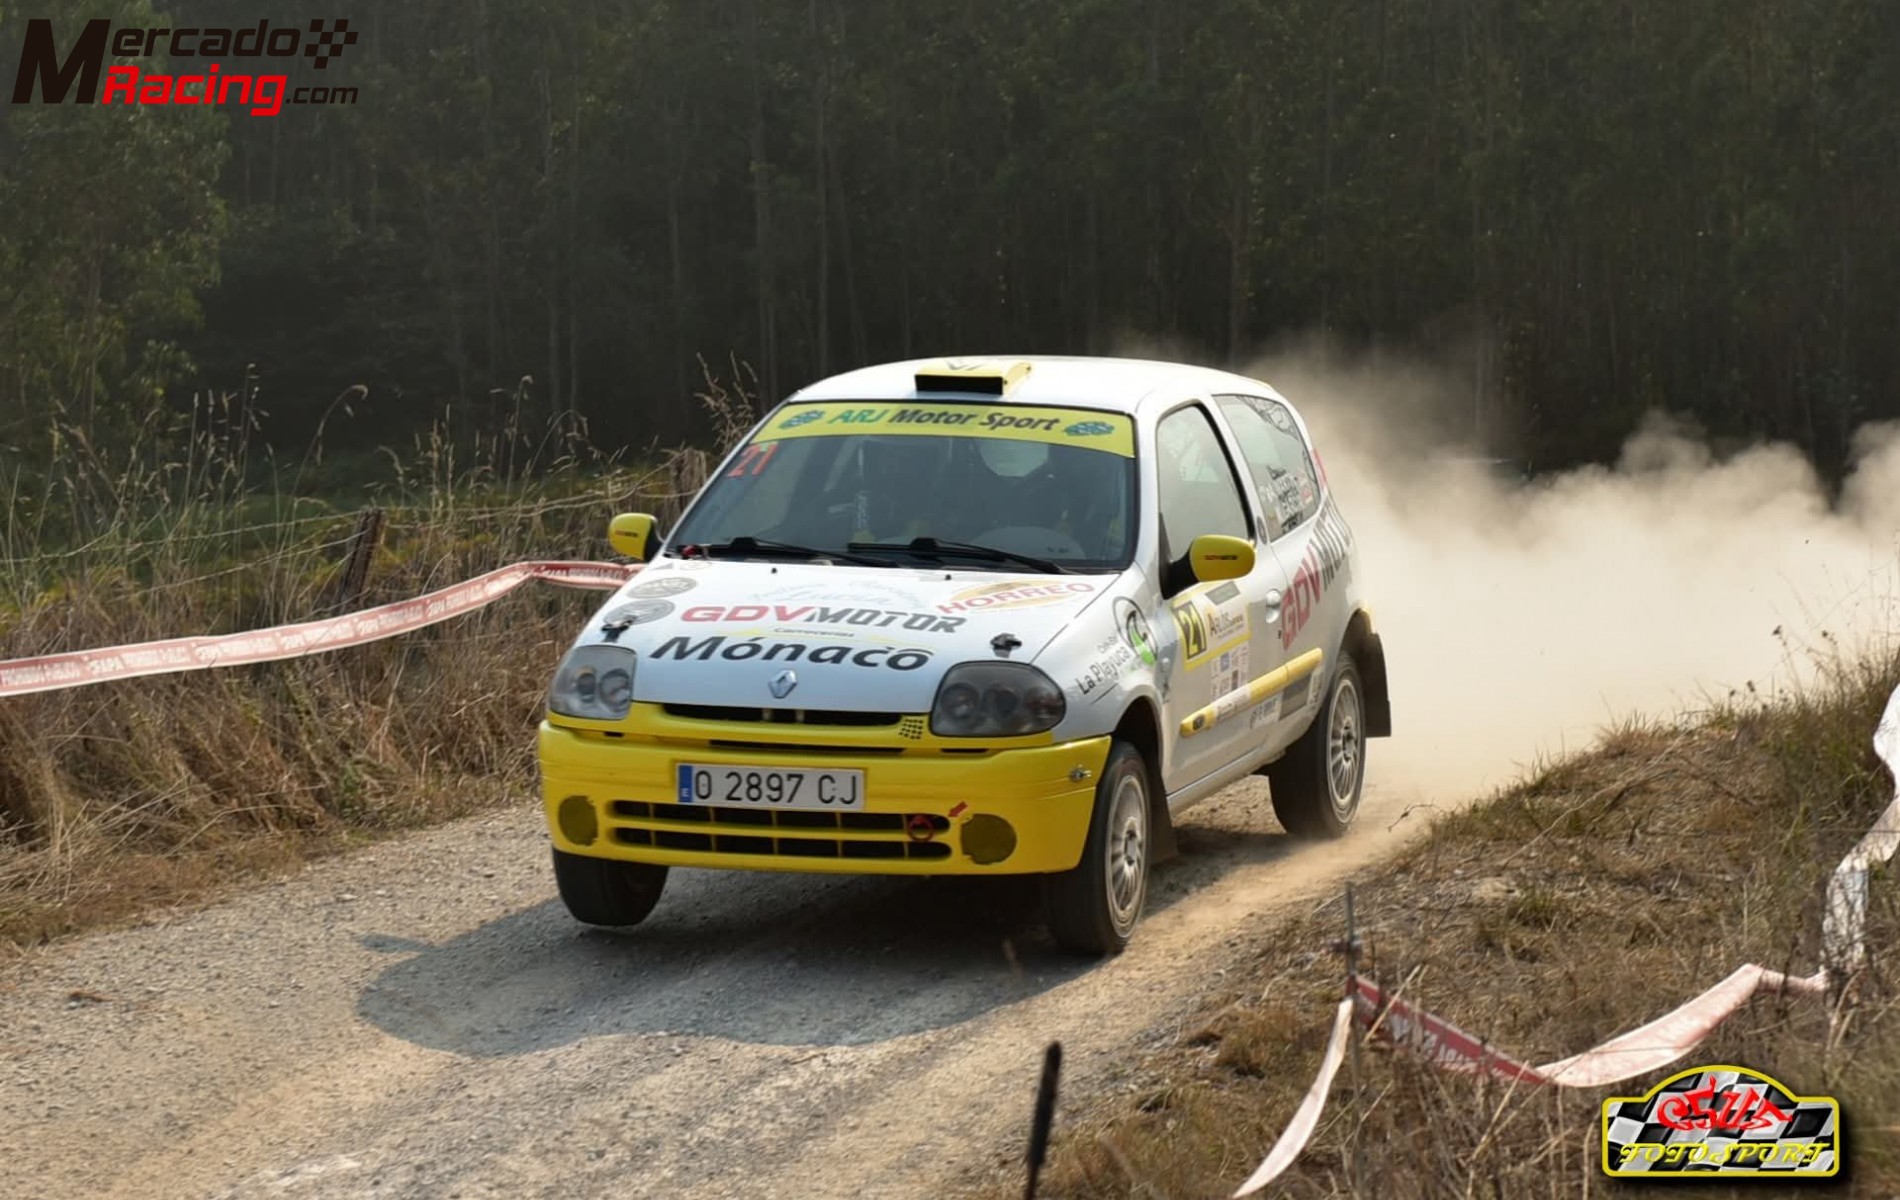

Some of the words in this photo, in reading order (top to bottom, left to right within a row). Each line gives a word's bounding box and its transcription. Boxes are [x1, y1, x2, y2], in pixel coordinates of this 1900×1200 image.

[828, 409, 889, 424] ARJ
[888, 409, 978, 425] Motor
[979, 412, 1060, 430] Sport
[727, 444, 779, 478] 21
[936, 583, 1095, 614] HORREO
[650, 637, 933, 671] Mónaco
[1075, 675, 1097, 695] La
[725, 771, 804, 804] 2897
[818, 775, 857, 805] CJ
